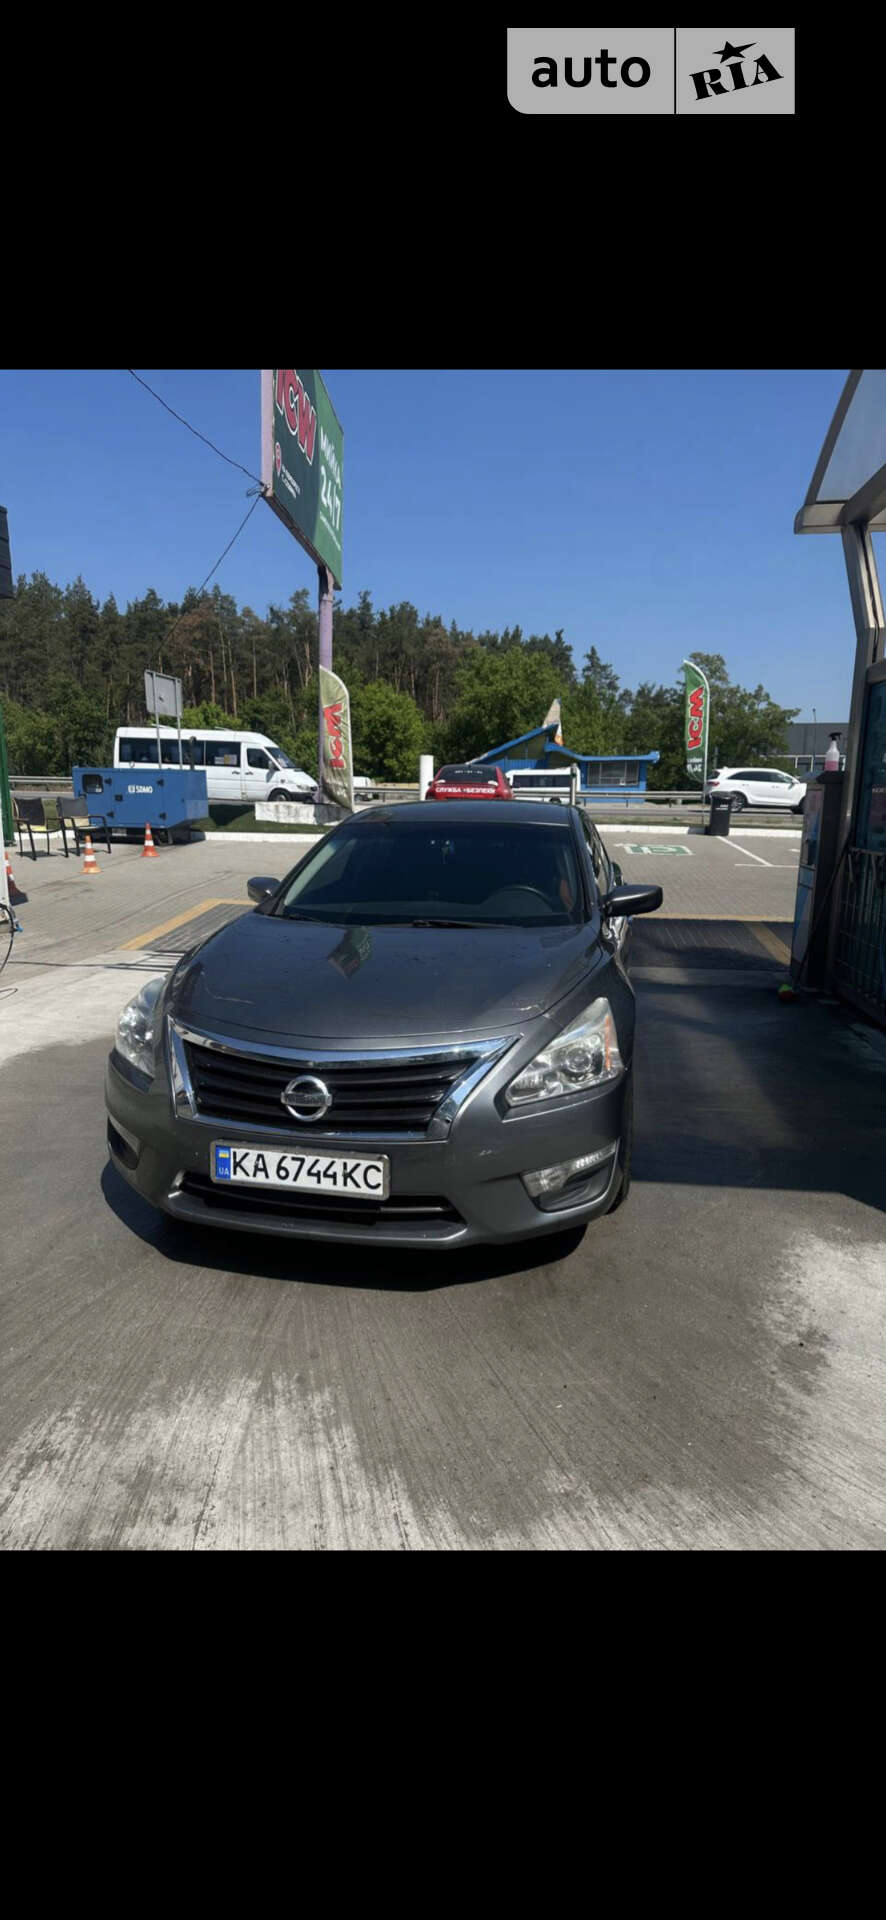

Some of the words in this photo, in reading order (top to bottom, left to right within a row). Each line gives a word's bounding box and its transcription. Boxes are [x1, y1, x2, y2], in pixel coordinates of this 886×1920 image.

[219, 1167, 230, 1176] UA
[232, 1151, 269, 1179] KA
[276, 1155, 337, 1186] 6744
[342, 1161, 382, 1190] KC
